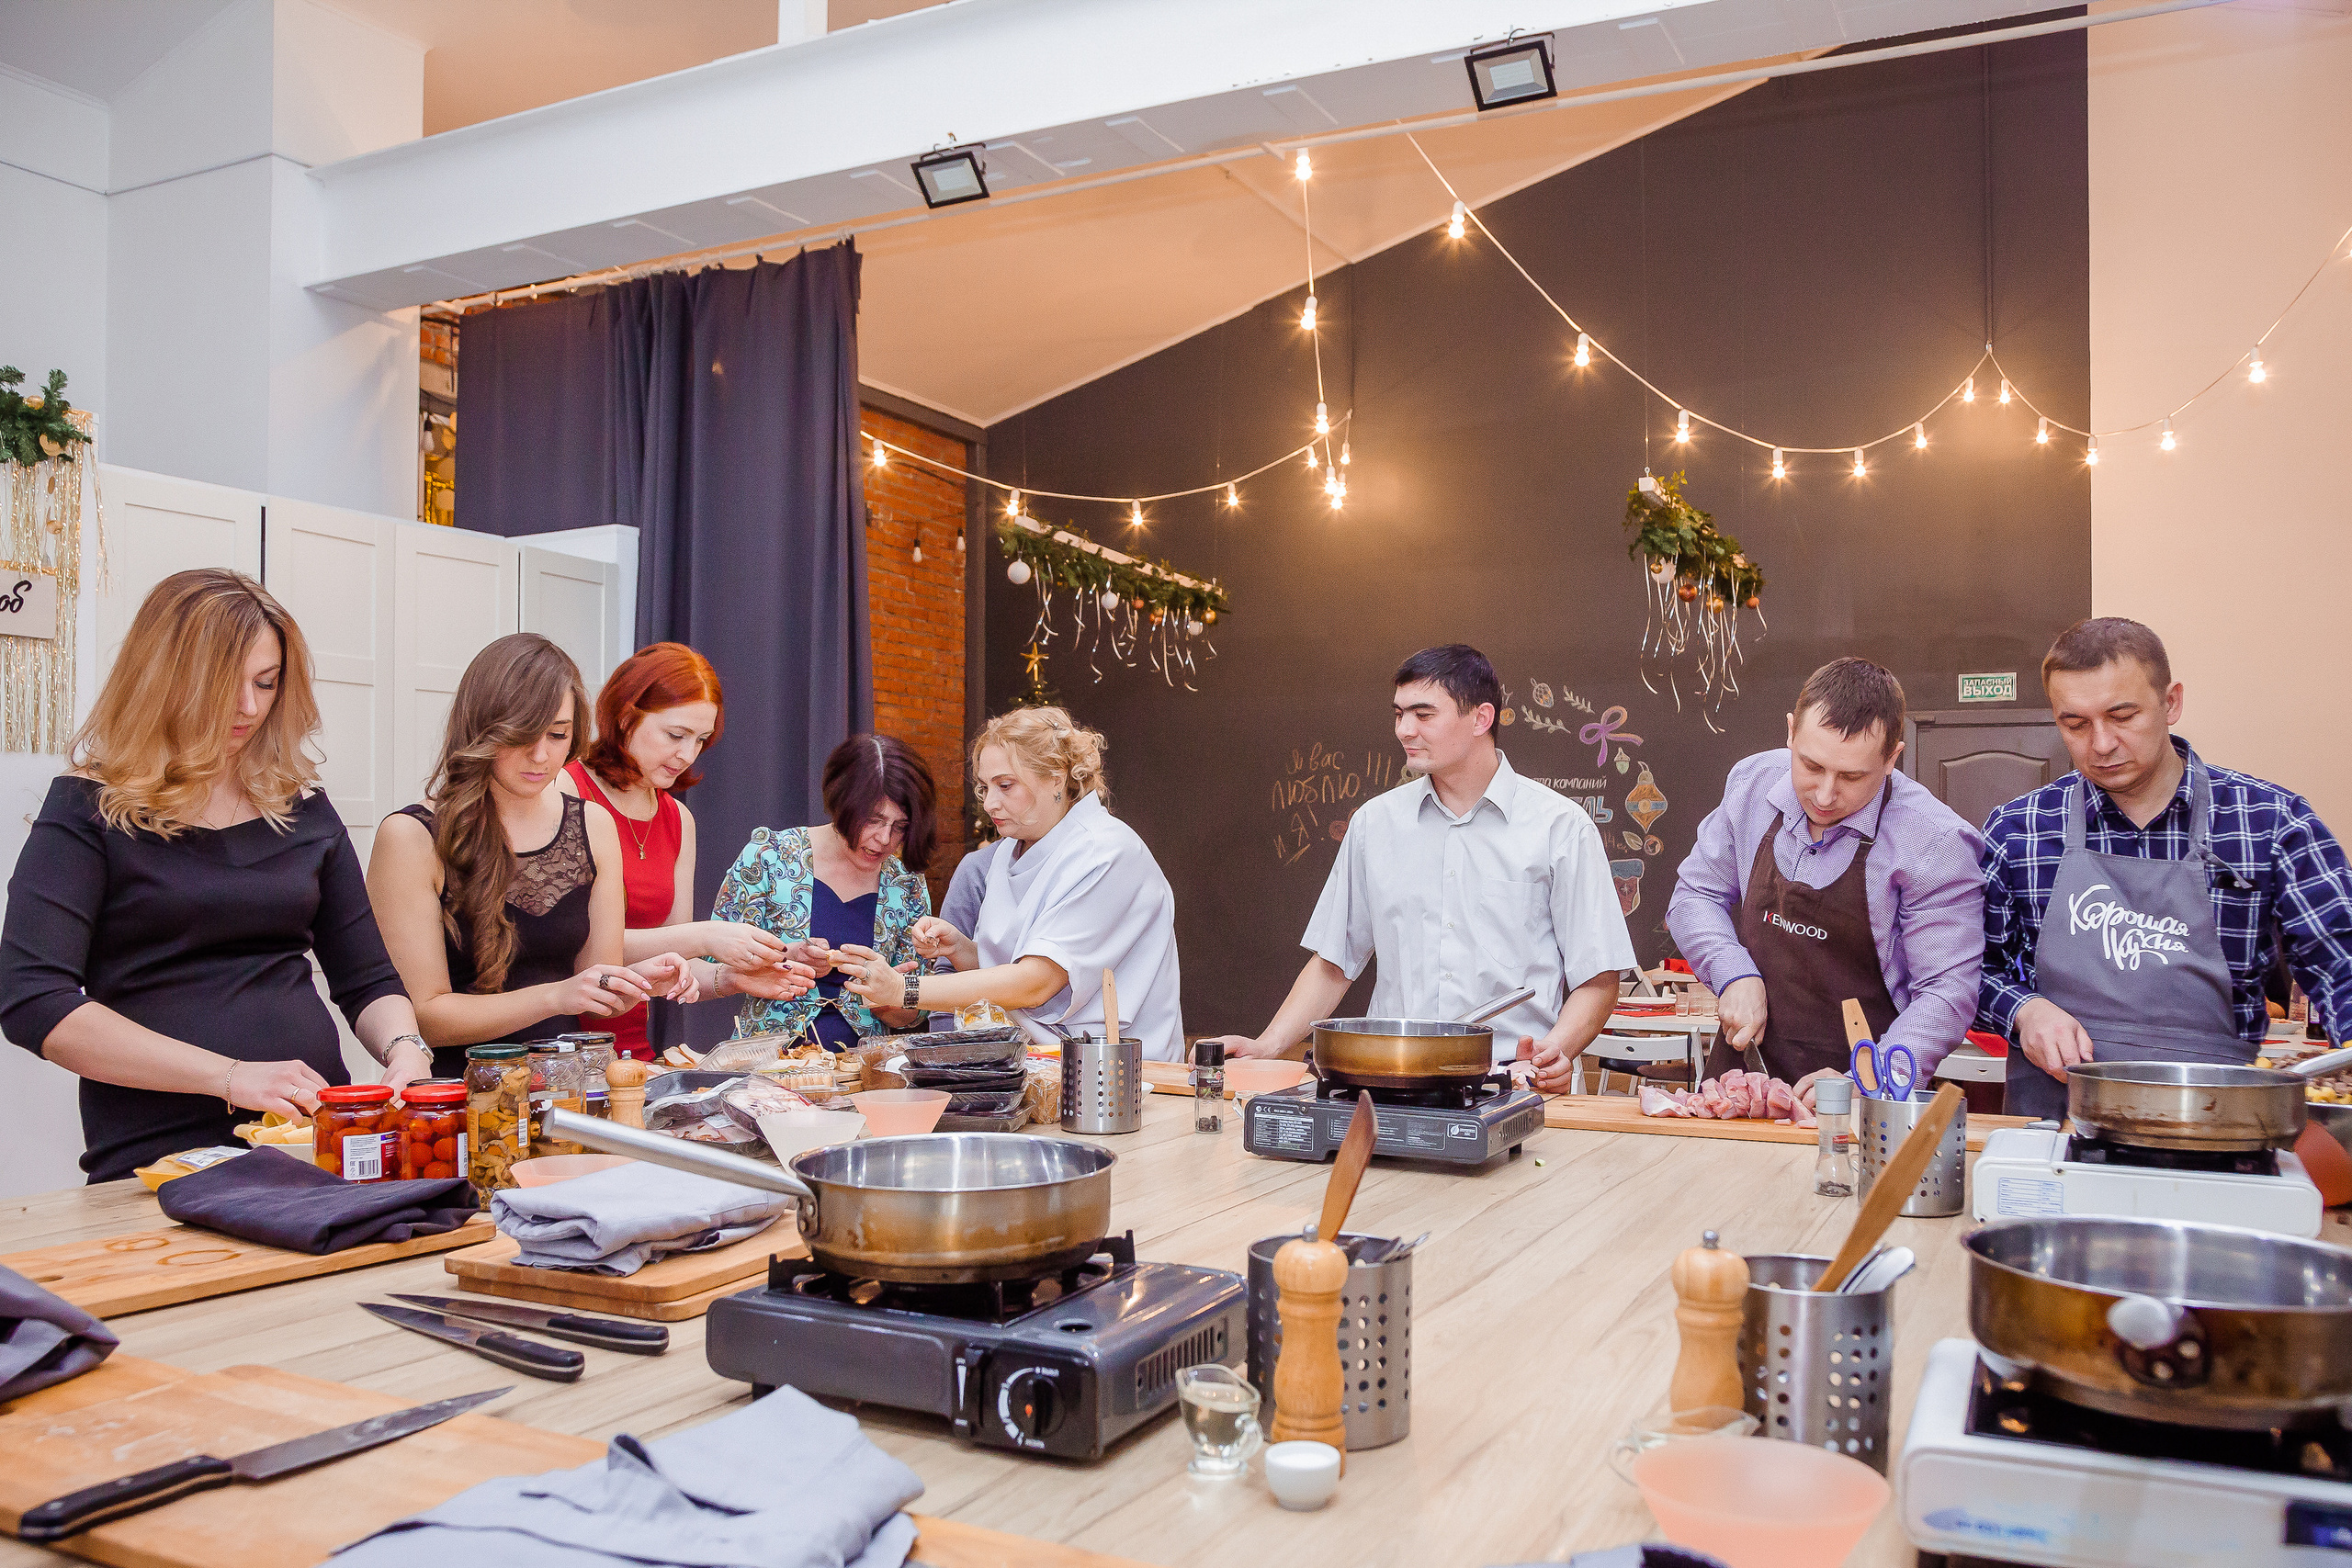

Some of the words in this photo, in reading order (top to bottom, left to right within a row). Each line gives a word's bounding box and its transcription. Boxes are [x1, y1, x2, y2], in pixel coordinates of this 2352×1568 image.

[1963, 676, 2012, 686] ЗАПАСНЫЙ
[1963, 684, 2012, 696] ВЫХОД
[1763, 910, 1827, 940] KENWOOD
